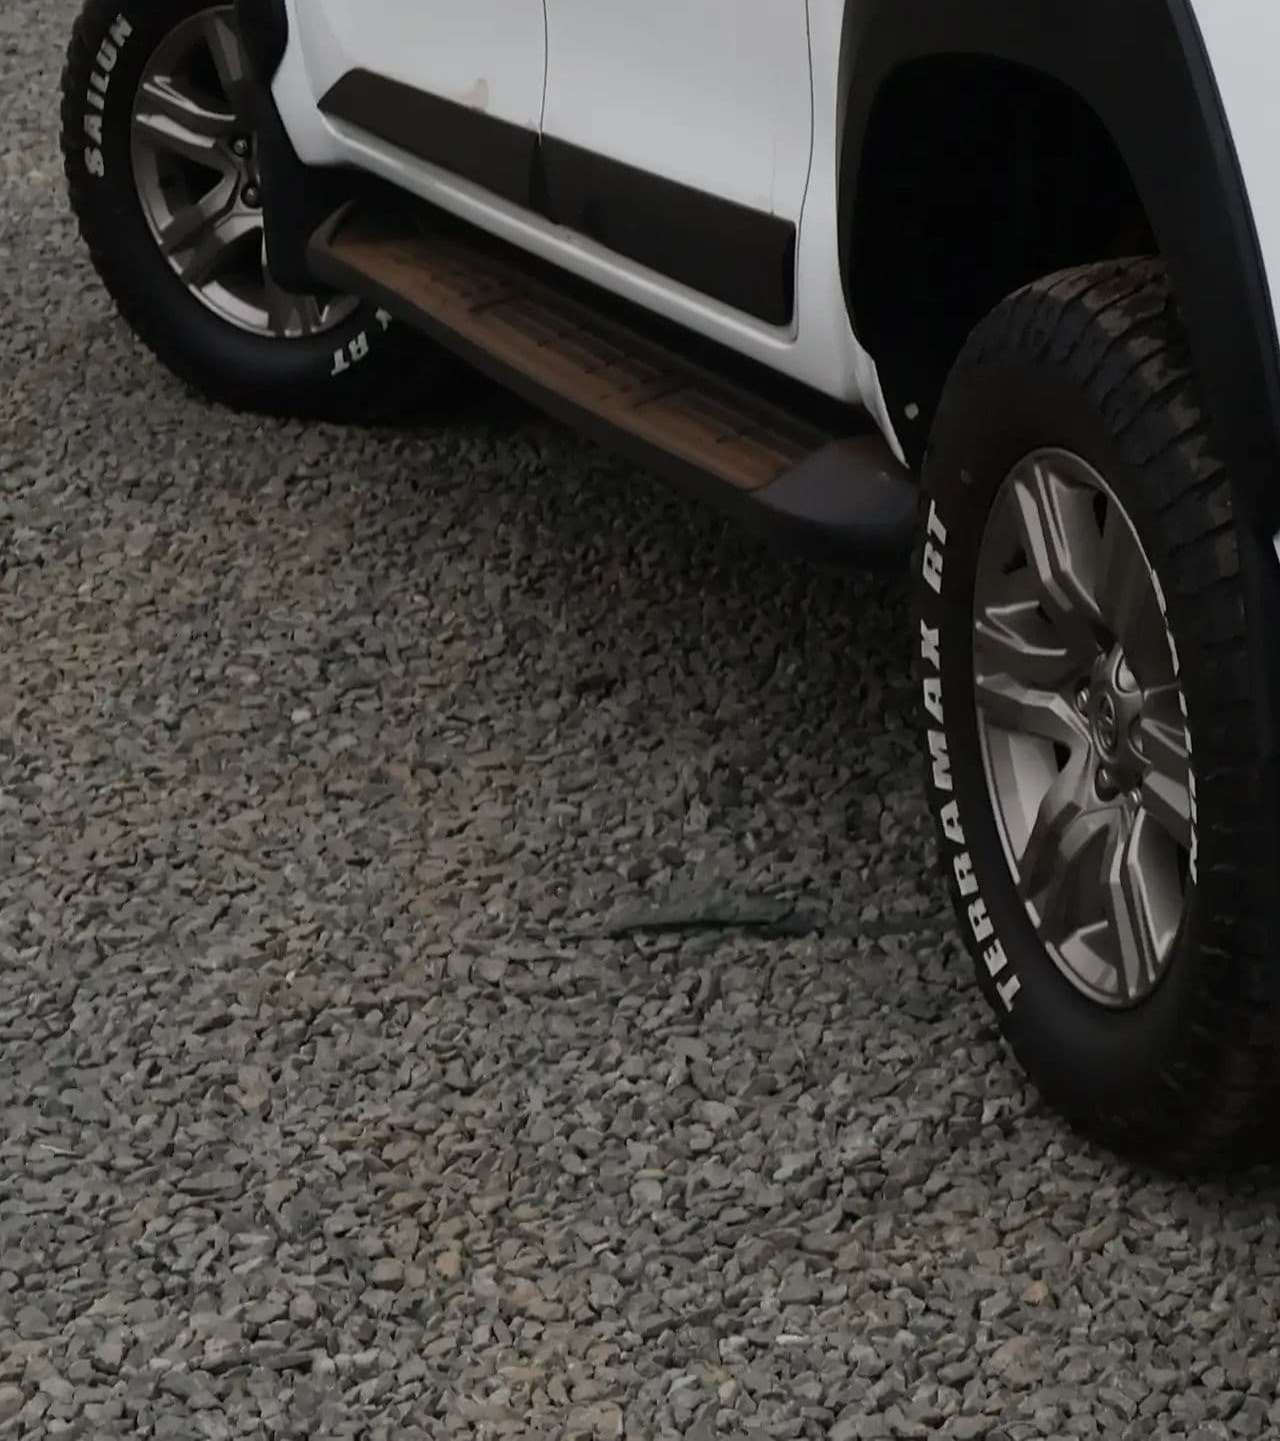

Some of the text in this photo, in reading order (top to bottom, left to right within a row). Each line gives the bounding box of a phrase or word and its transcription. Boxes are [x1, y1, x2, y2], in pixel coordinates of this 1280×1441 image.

[84, 13, 133, 177] SAILUN
[920, 498, 1021, 1013] TERRAMAX RT
